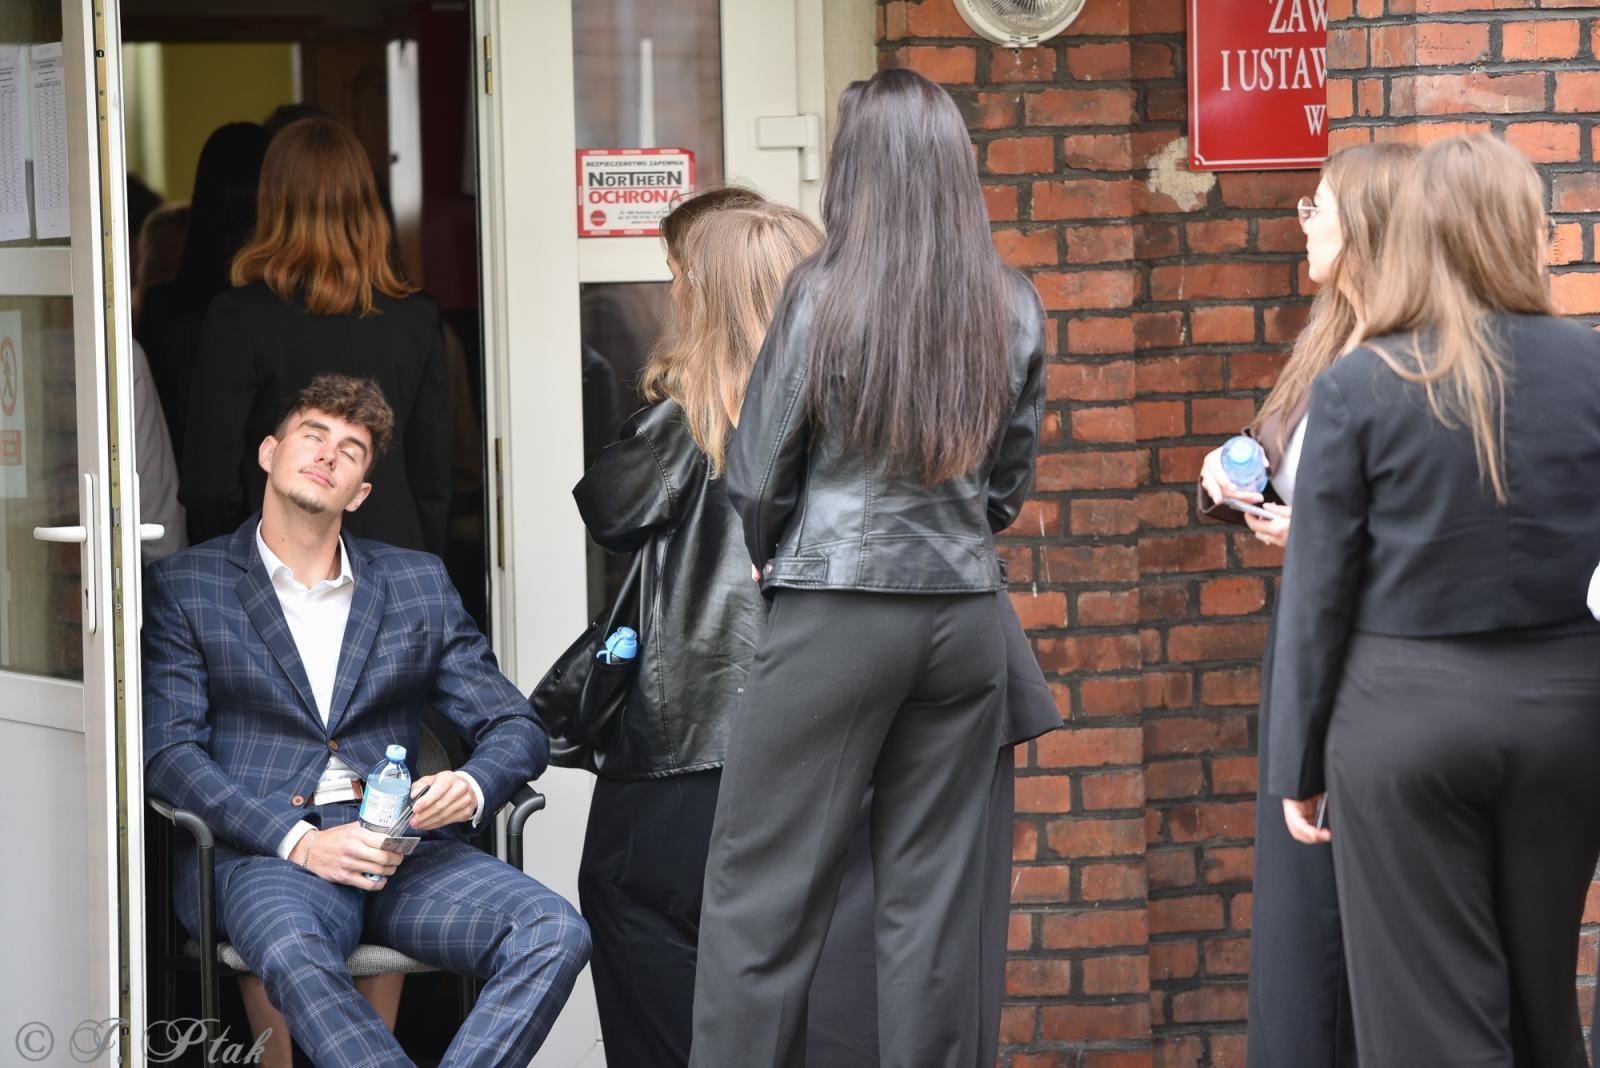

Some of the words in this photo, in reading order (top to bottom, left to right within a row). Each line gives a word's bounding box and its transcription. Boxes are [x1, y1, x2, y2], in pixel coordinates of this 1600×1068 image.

[1221, 50, 1231, 91] I
[1304, 105, 1326, 136] W
[588, 189, 682, 204] OCHRONA
